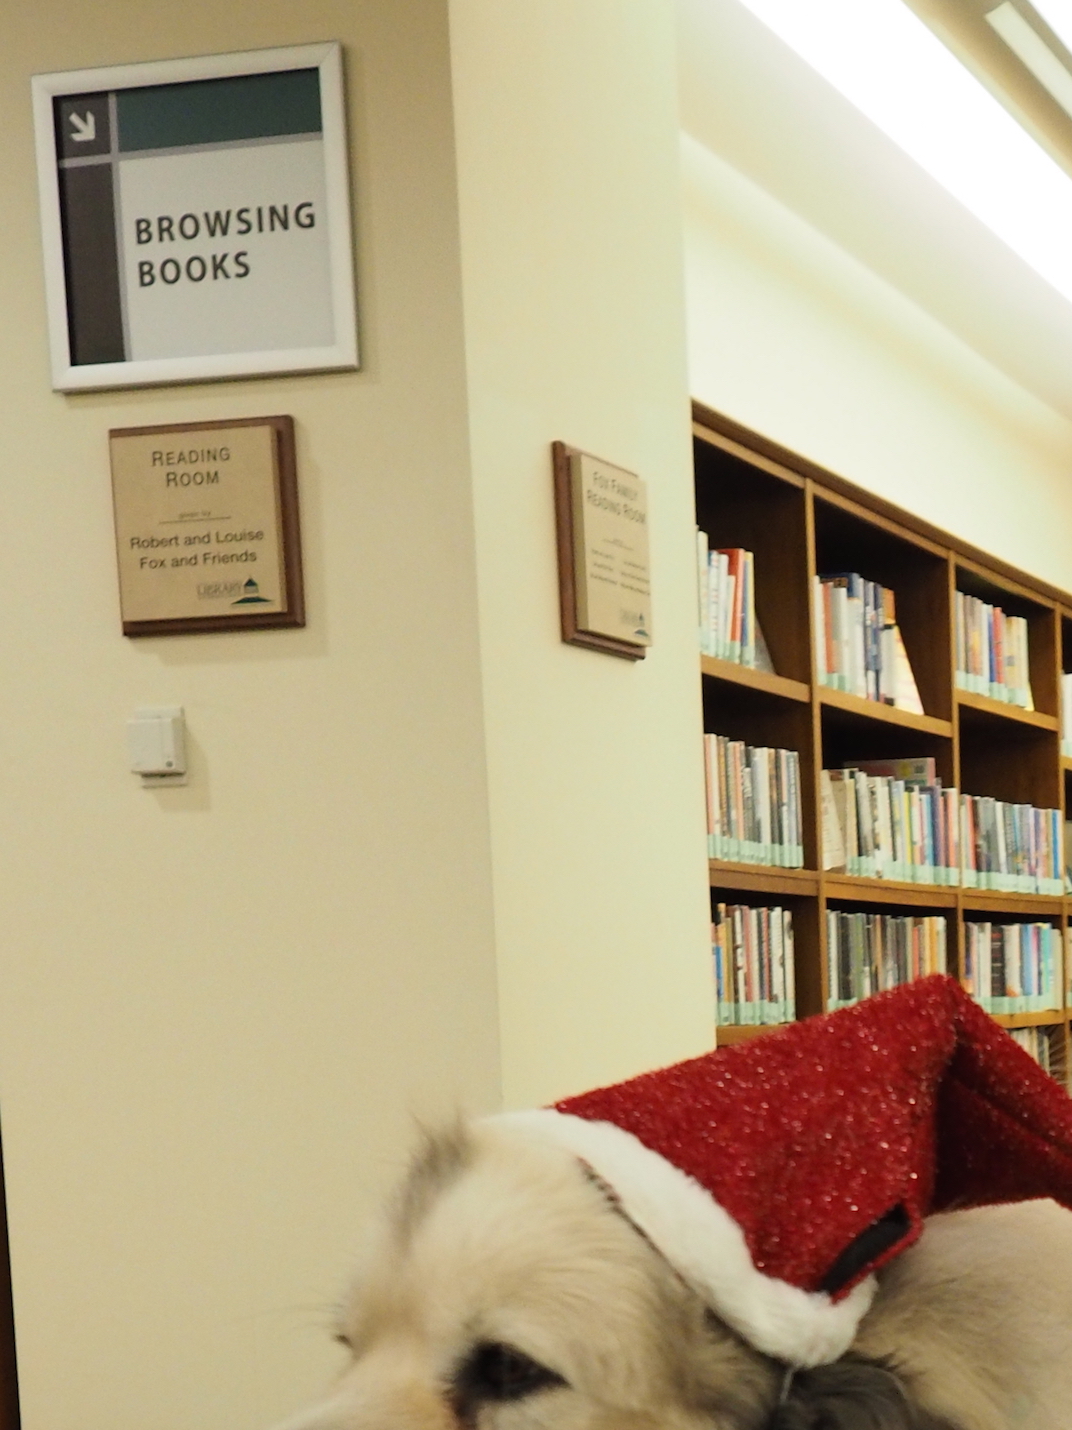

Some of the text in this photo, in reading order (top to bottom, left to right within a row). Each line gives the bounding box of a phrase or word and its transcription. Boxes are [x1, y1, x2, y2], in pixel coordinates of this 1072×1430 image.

[135, 202, 316, 245] BROWSING
[138, 251, 251, 287] BOOKS
[152, 447, 231, 467] READING
[166, 470, 219, 488] ROOM
[130, 529, 264, 550] Robert and Louise
[140, 549, 257, 569] Fox and Friends
